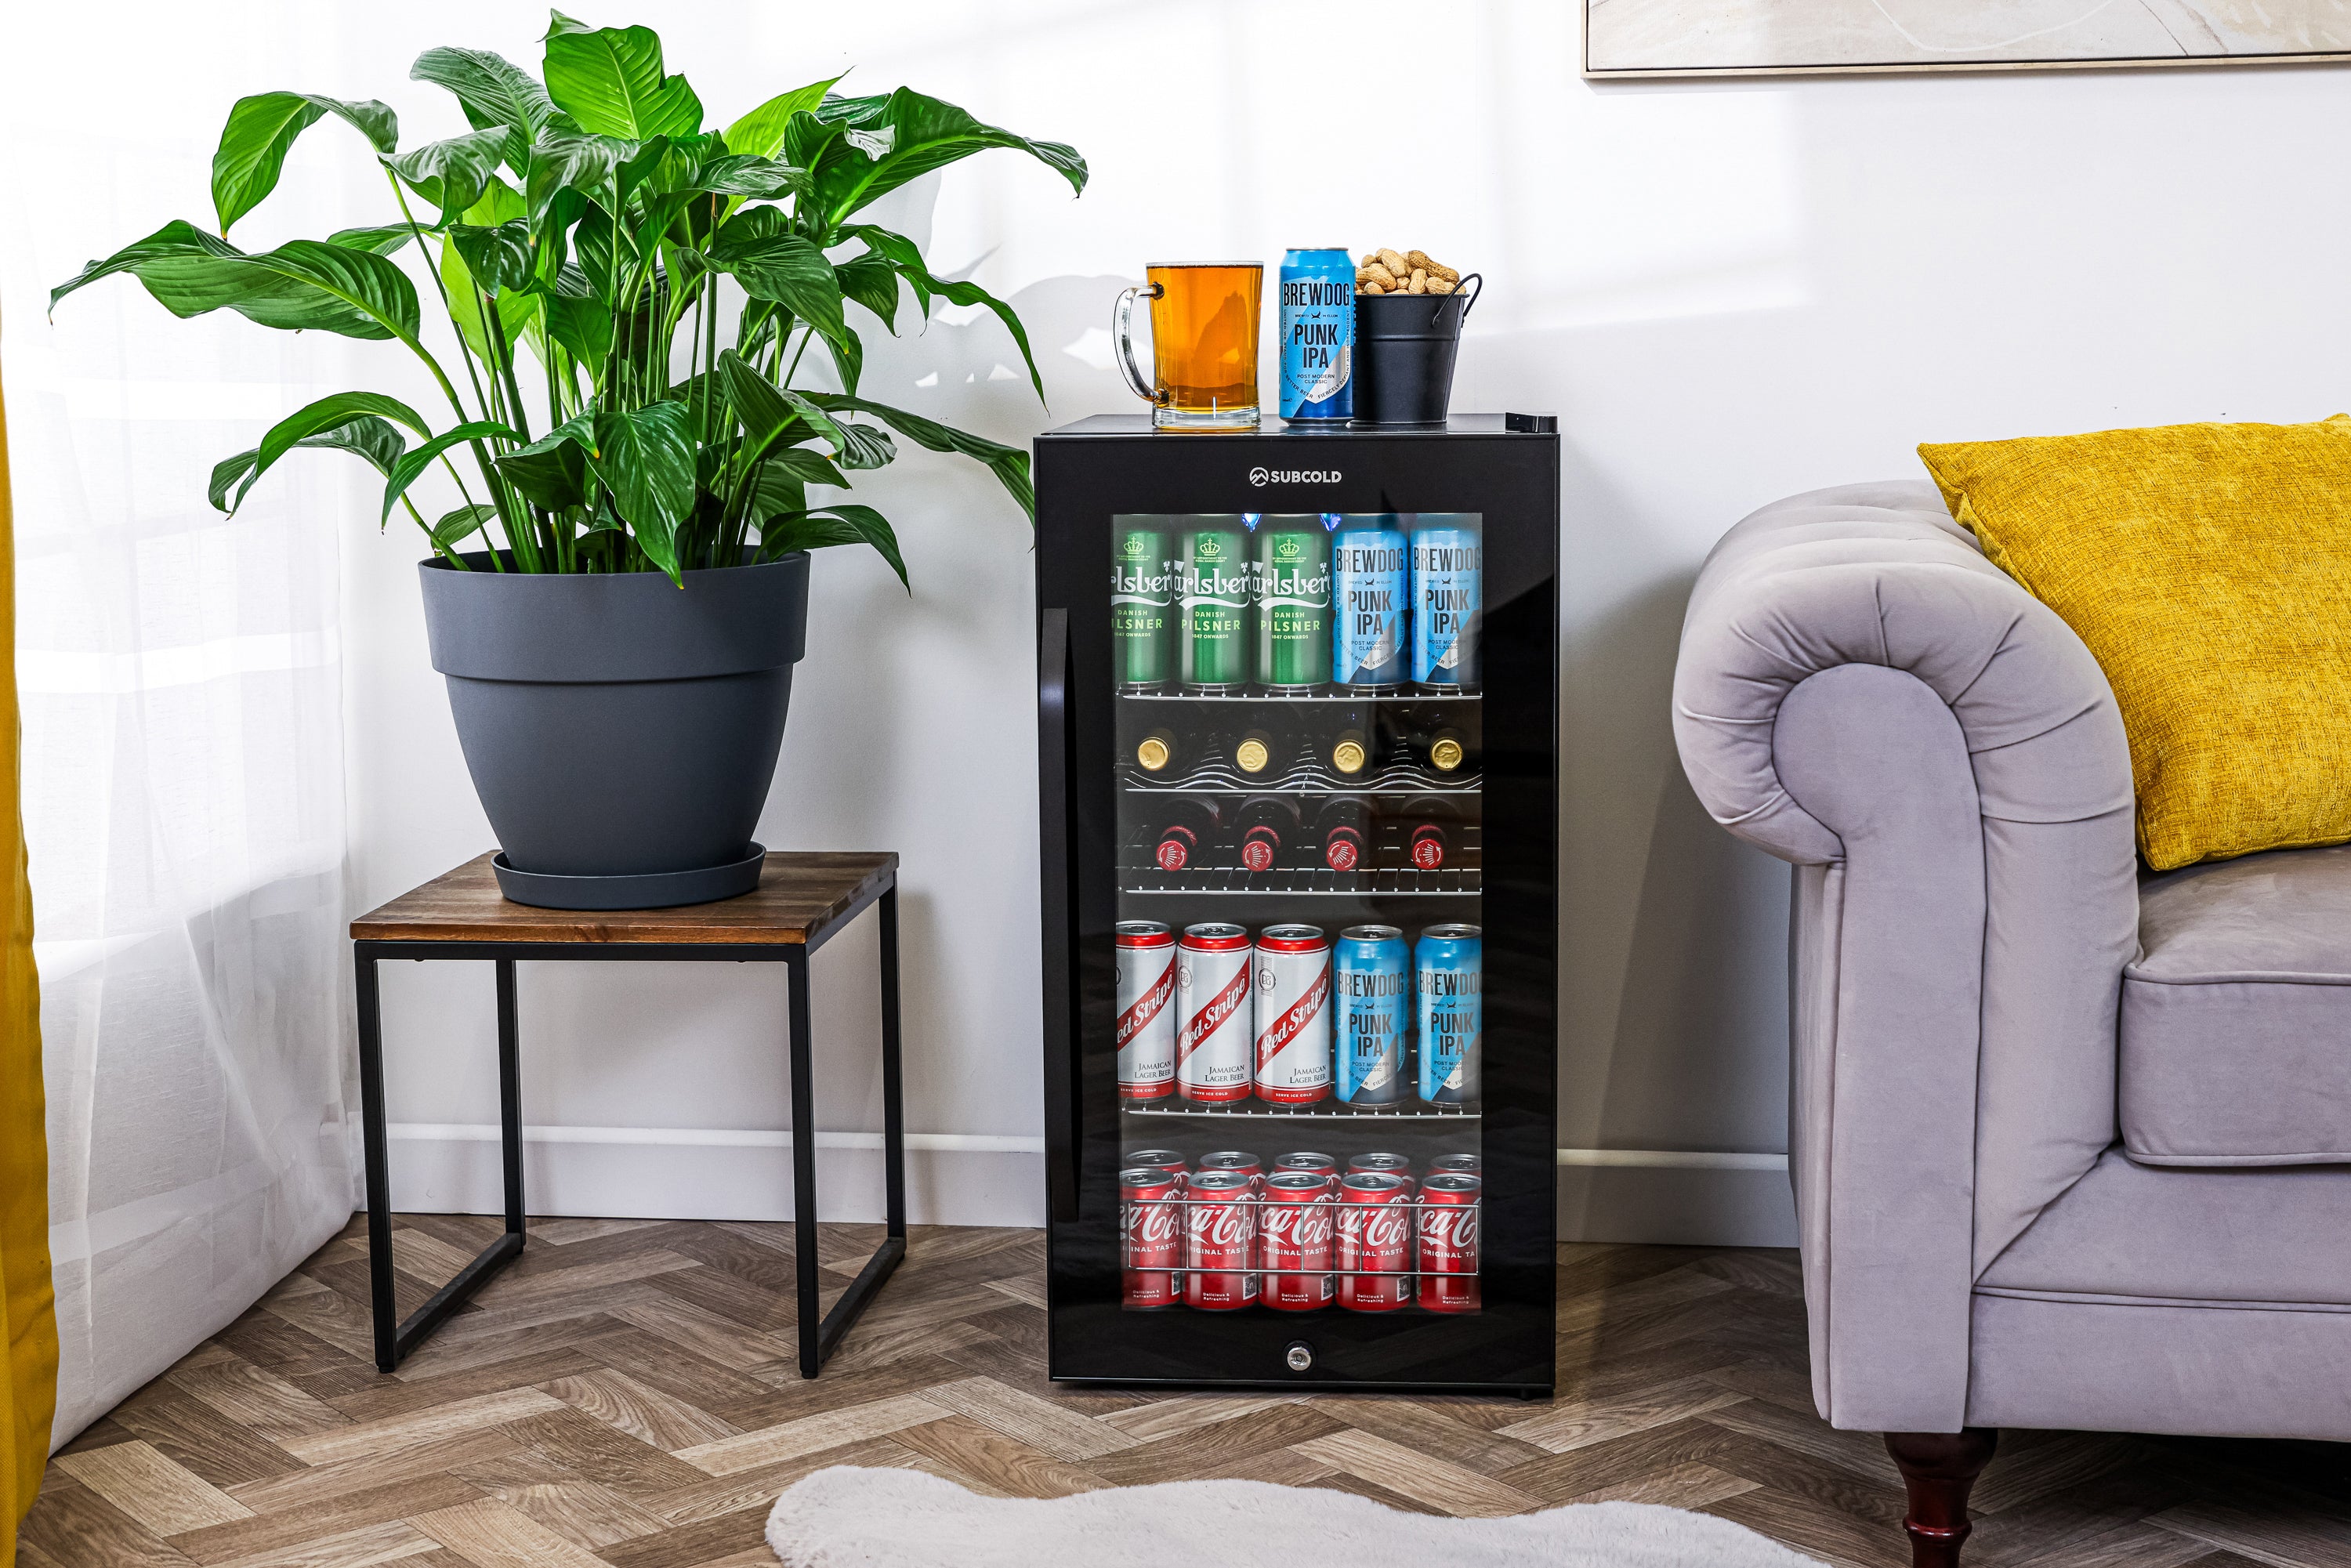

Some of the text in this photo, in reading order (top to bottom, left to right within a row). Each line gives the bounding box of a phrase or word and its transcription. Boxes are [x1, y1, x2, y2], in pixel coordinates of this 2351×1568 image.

[1284, 283, 1349, 306] BREWDOG
[1294, 324, 1338, 345] PUNK
[1303, 347, 1329, 368] IPA
[1286, 375, 1299, 390] BETTER
[1300, 389, 1313, 399] BEER
[1318, 383, 1340, 399] FIERCELY
[1339, 364, 1349, 385] DEFIANT
[1270, 470, 1342, 483] SUBCOLD
[1336, 549, 1404, 573] BREWDOG
[1348, 590, 1393, 612] PUNK
[1425, 589, 1469, 610] PUNK
[1111, 618, 1163, 629] ILSNER
[1181, 620, 1241, 631] PILSNER
[1260, 620, 1320, 632] PILSNER
[1357, 614, 1383, 636] IPA
[1434, 613, 1460, 634] IPA
[1354, 656, 1368, 665] BEER
[1431, 654, 1445, 664] BEER
[1338, 971, 1404, 997] BREWDOG
[1117, 973, 1172, 1043] ed Stripe
[1180, 977, 1245, 1056] Red Stripe
[1261, 978, 1327, 1059] Red Stripe
[1349, 1013, 1393, 1034] PUNK
[1430, 1012, 1474, 1034] PUNK
[1357, 1037, 1384, 1056] IPA
[1440, 1035, 1465, 1056] IPA
[1134, 1069, 1171, 1079] LAGER BEER
[1139, 1060, 1172, 1071] JAMAICAN
[1208, 1065, 1244, 1075] JAMAICAN
[1294, 1065, 1327, 1077] JAMAICAN
[1313, 1074, 1326, 1082] BEER
[1355, 1076, 1368, 1086] BEER
[1437, 1075, 1451, 1085] BEER
[1189, 1247, 1223, 1255] RIGINAL
[1263, 1246, 1328, 1255] ORIGINAL TASTE
[1380, 1248, 1404, 1256] TASTE
[1422, 1249, 1462, 1258] ORIGINAL
